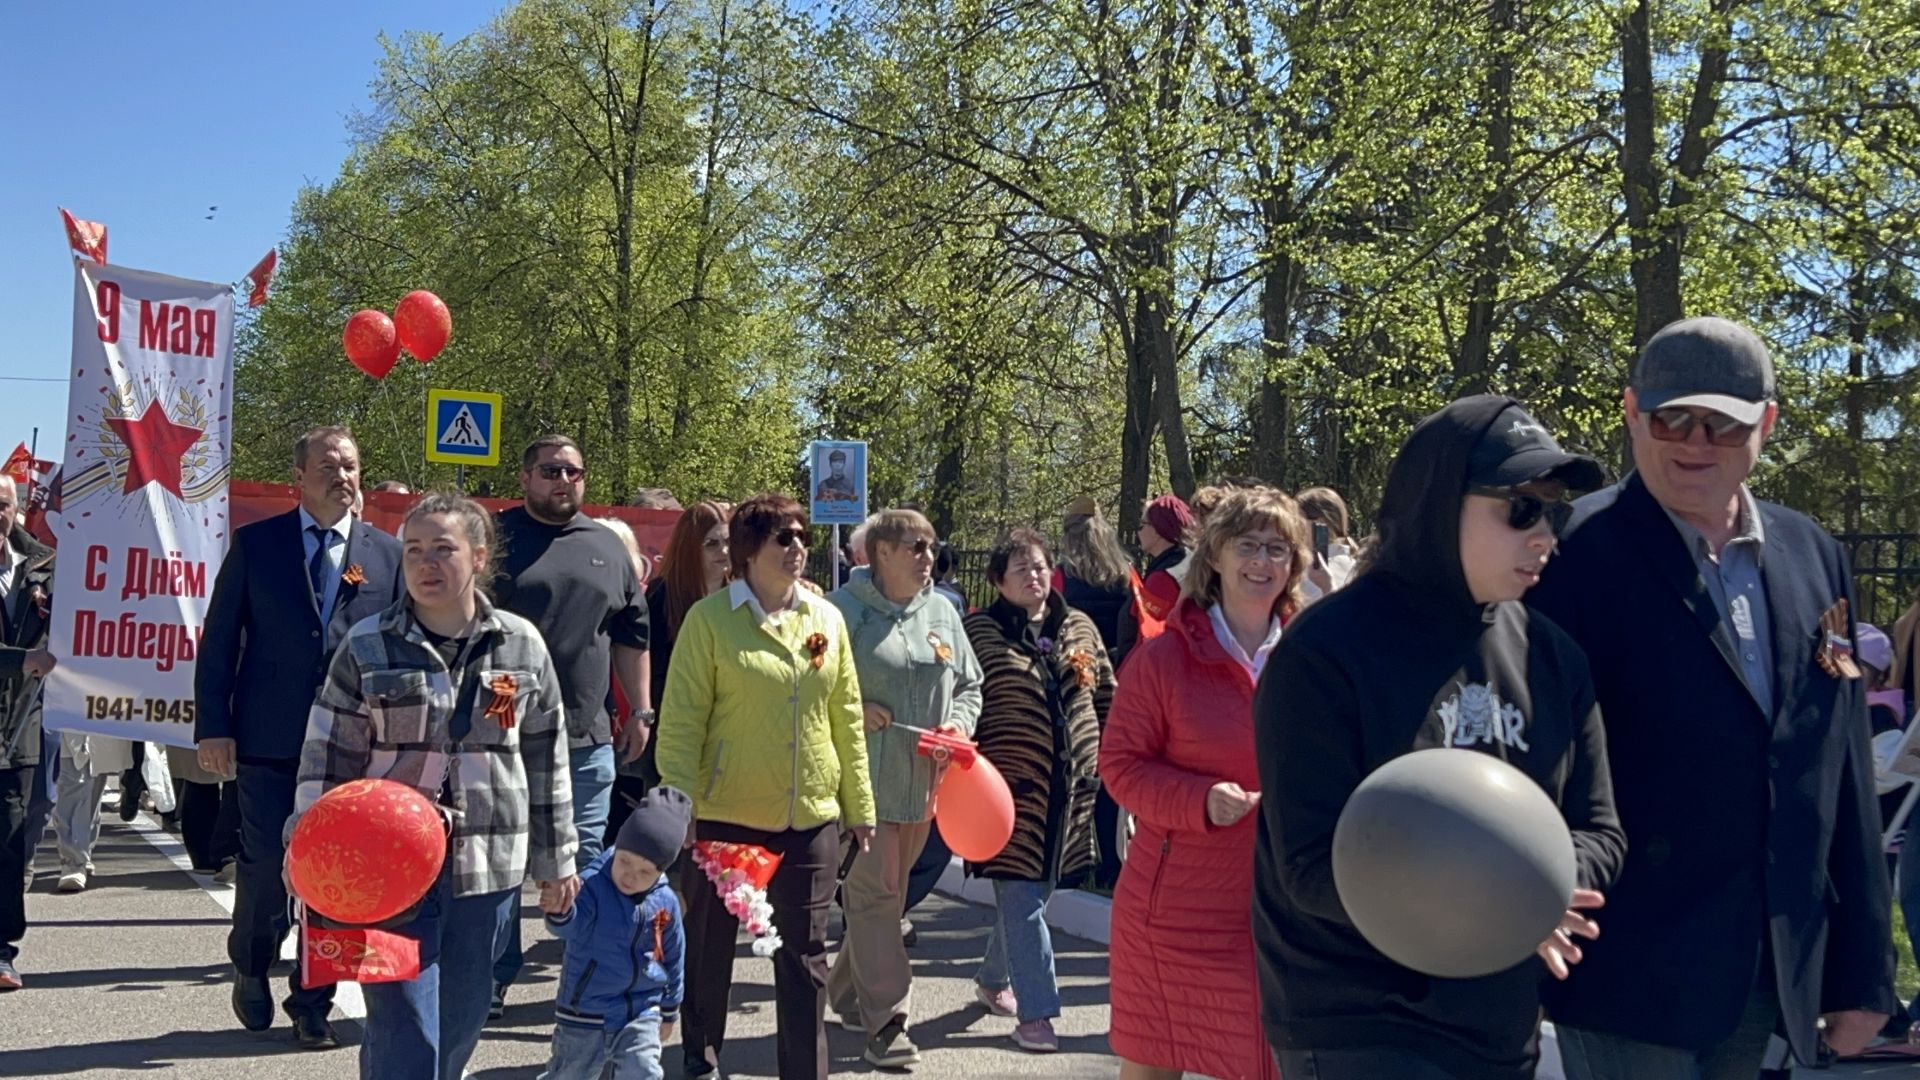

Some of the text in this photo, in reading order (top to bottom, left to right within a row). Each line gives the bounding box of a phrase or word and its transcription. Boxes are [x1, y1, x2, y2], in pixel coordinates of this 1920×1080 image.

[97, 281, 216, 358] 9 мая
[85, 544, 206, 602] С Днём
[86, 695, 195, 724] 1941-1945
